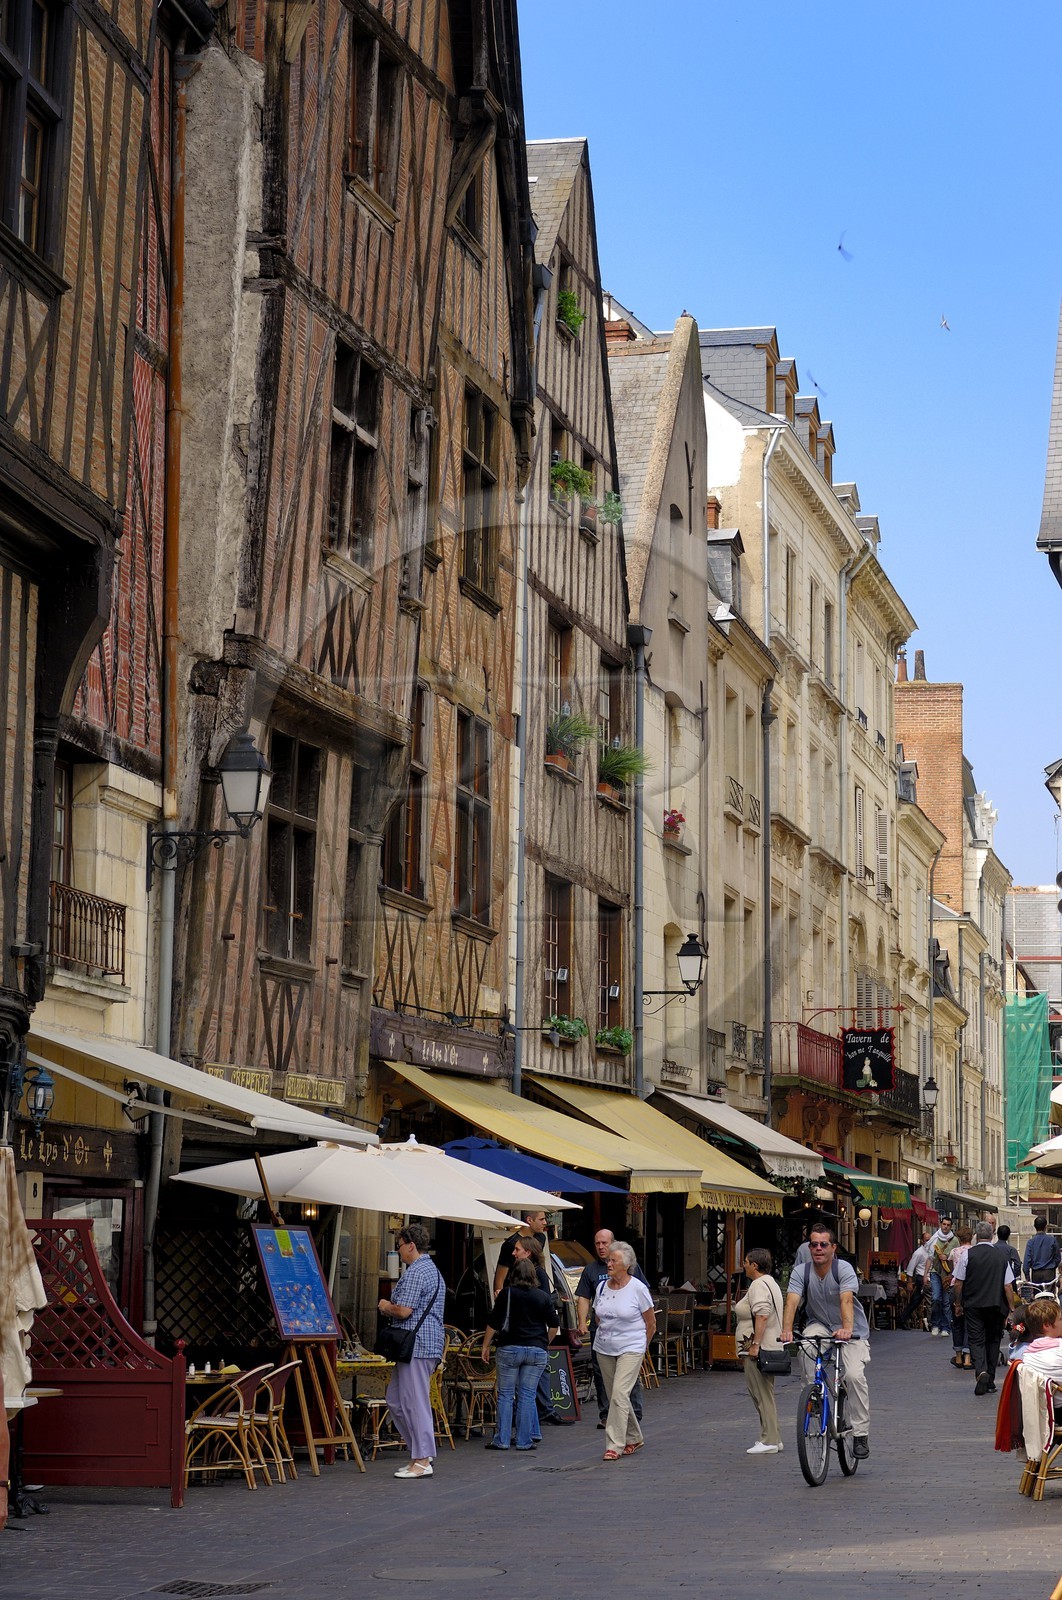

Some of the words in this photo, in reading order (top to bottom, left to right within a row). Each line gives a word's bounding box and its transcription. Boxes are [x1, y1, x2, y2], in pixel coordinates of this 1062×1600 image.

[880, 1032, 890, 1044] de
[423, 1040, 430, 1061] Le
[20, 1128, 34, 1162] Le
[38, 1130, 58, 1167] Lys
[63, 1133, 90, 1165] d'Or
[32, 1182, 38, 1199] 8
